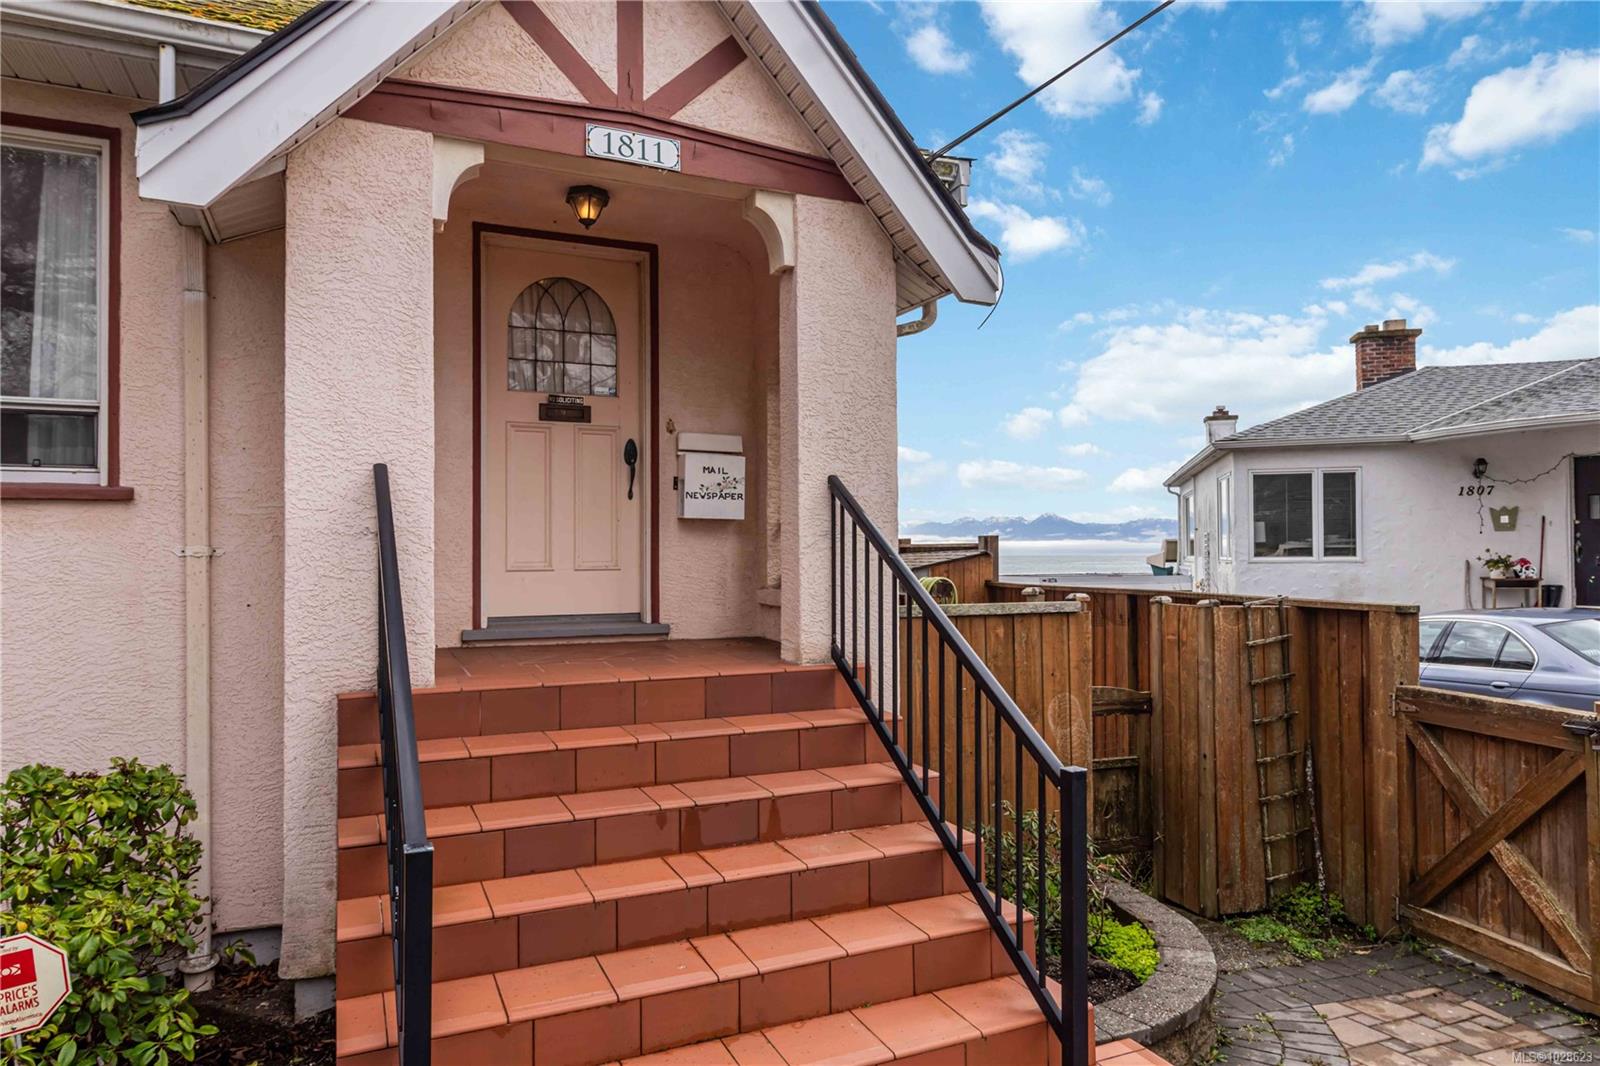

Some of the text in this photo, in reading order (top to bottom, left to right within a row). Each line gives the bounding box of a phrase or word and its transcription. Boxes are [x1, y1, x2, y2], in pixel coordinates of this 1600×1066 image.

[603, 132, 665, 164] 1811
[702, 466, 729, 475] MAIL
[1458, 485, 1495, 496] 1807
[0, 997, 40, 1017] ALARMS
